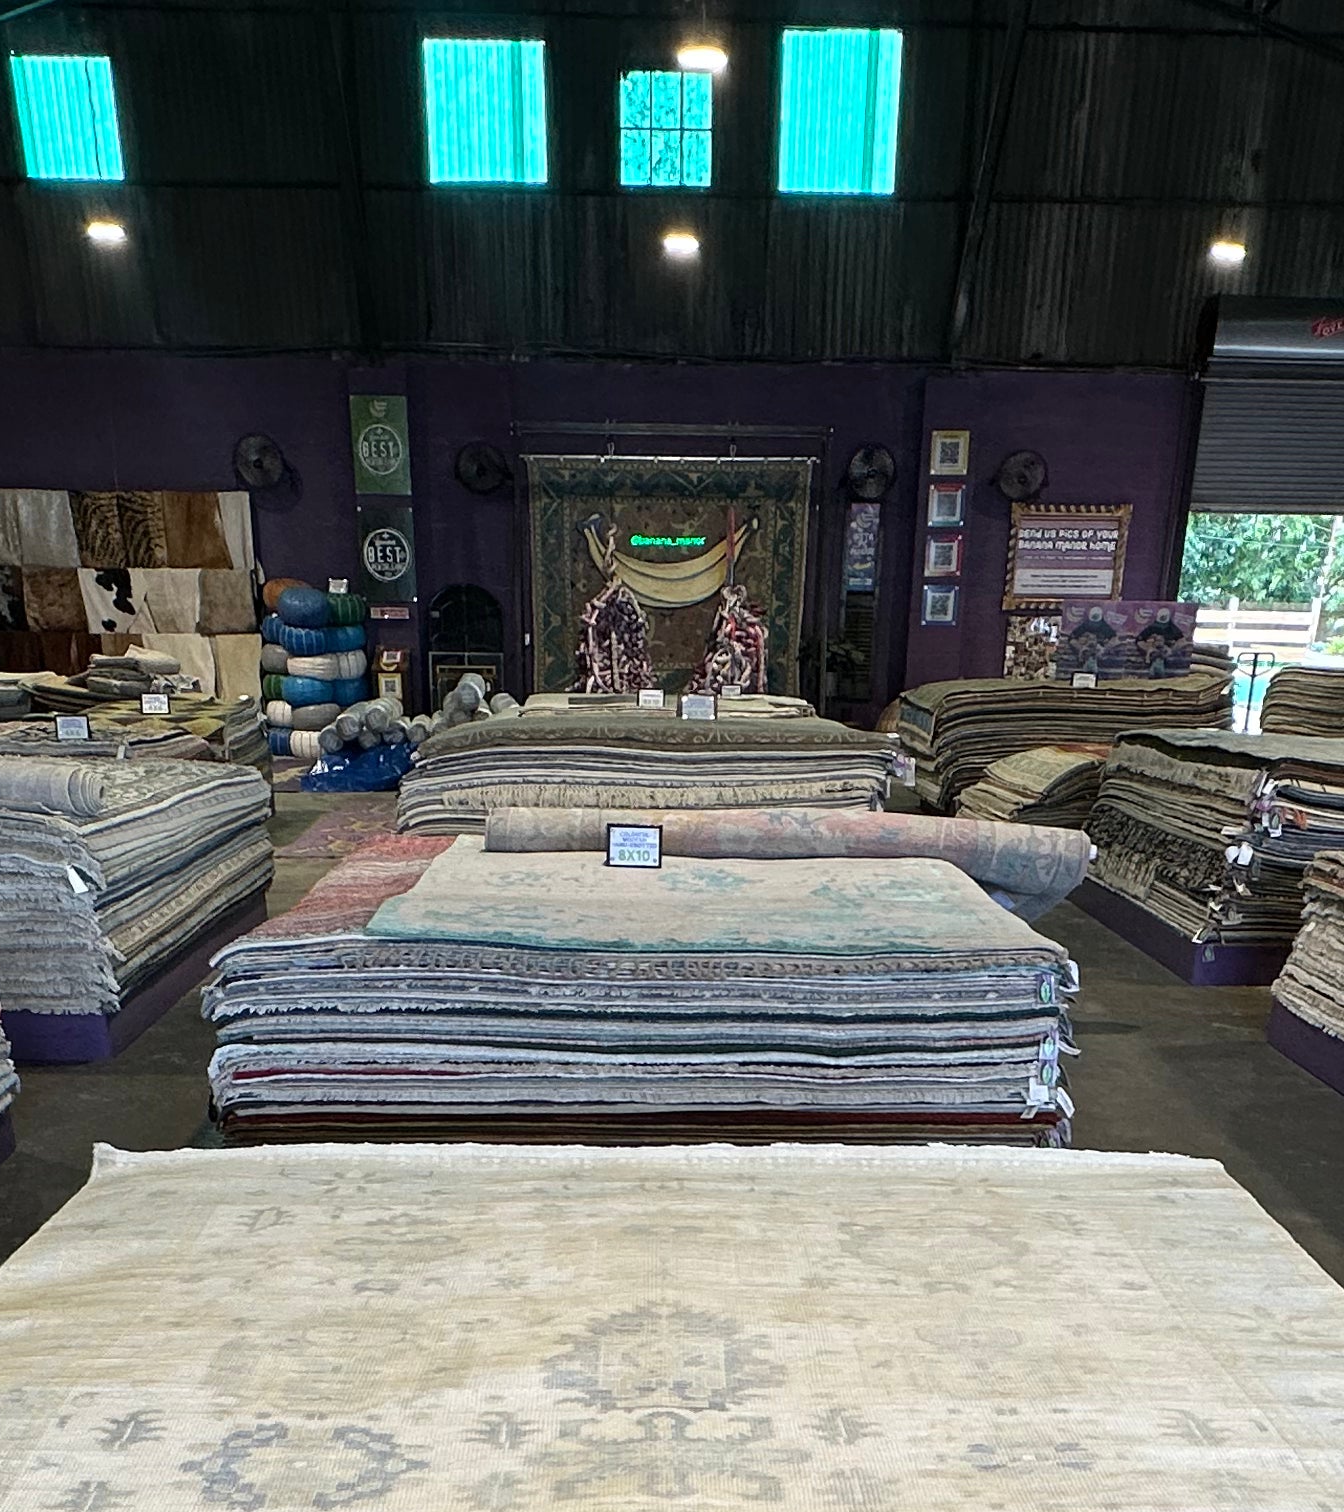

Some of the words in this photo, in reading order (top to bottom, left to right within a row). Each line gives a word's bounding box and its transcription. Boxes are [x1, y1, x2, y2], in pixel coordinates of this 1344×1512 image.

[361, 441, 394, 458] BEST
[367, 546, 402, 563] BEST
[618, 849, 651, 862] 8X10
